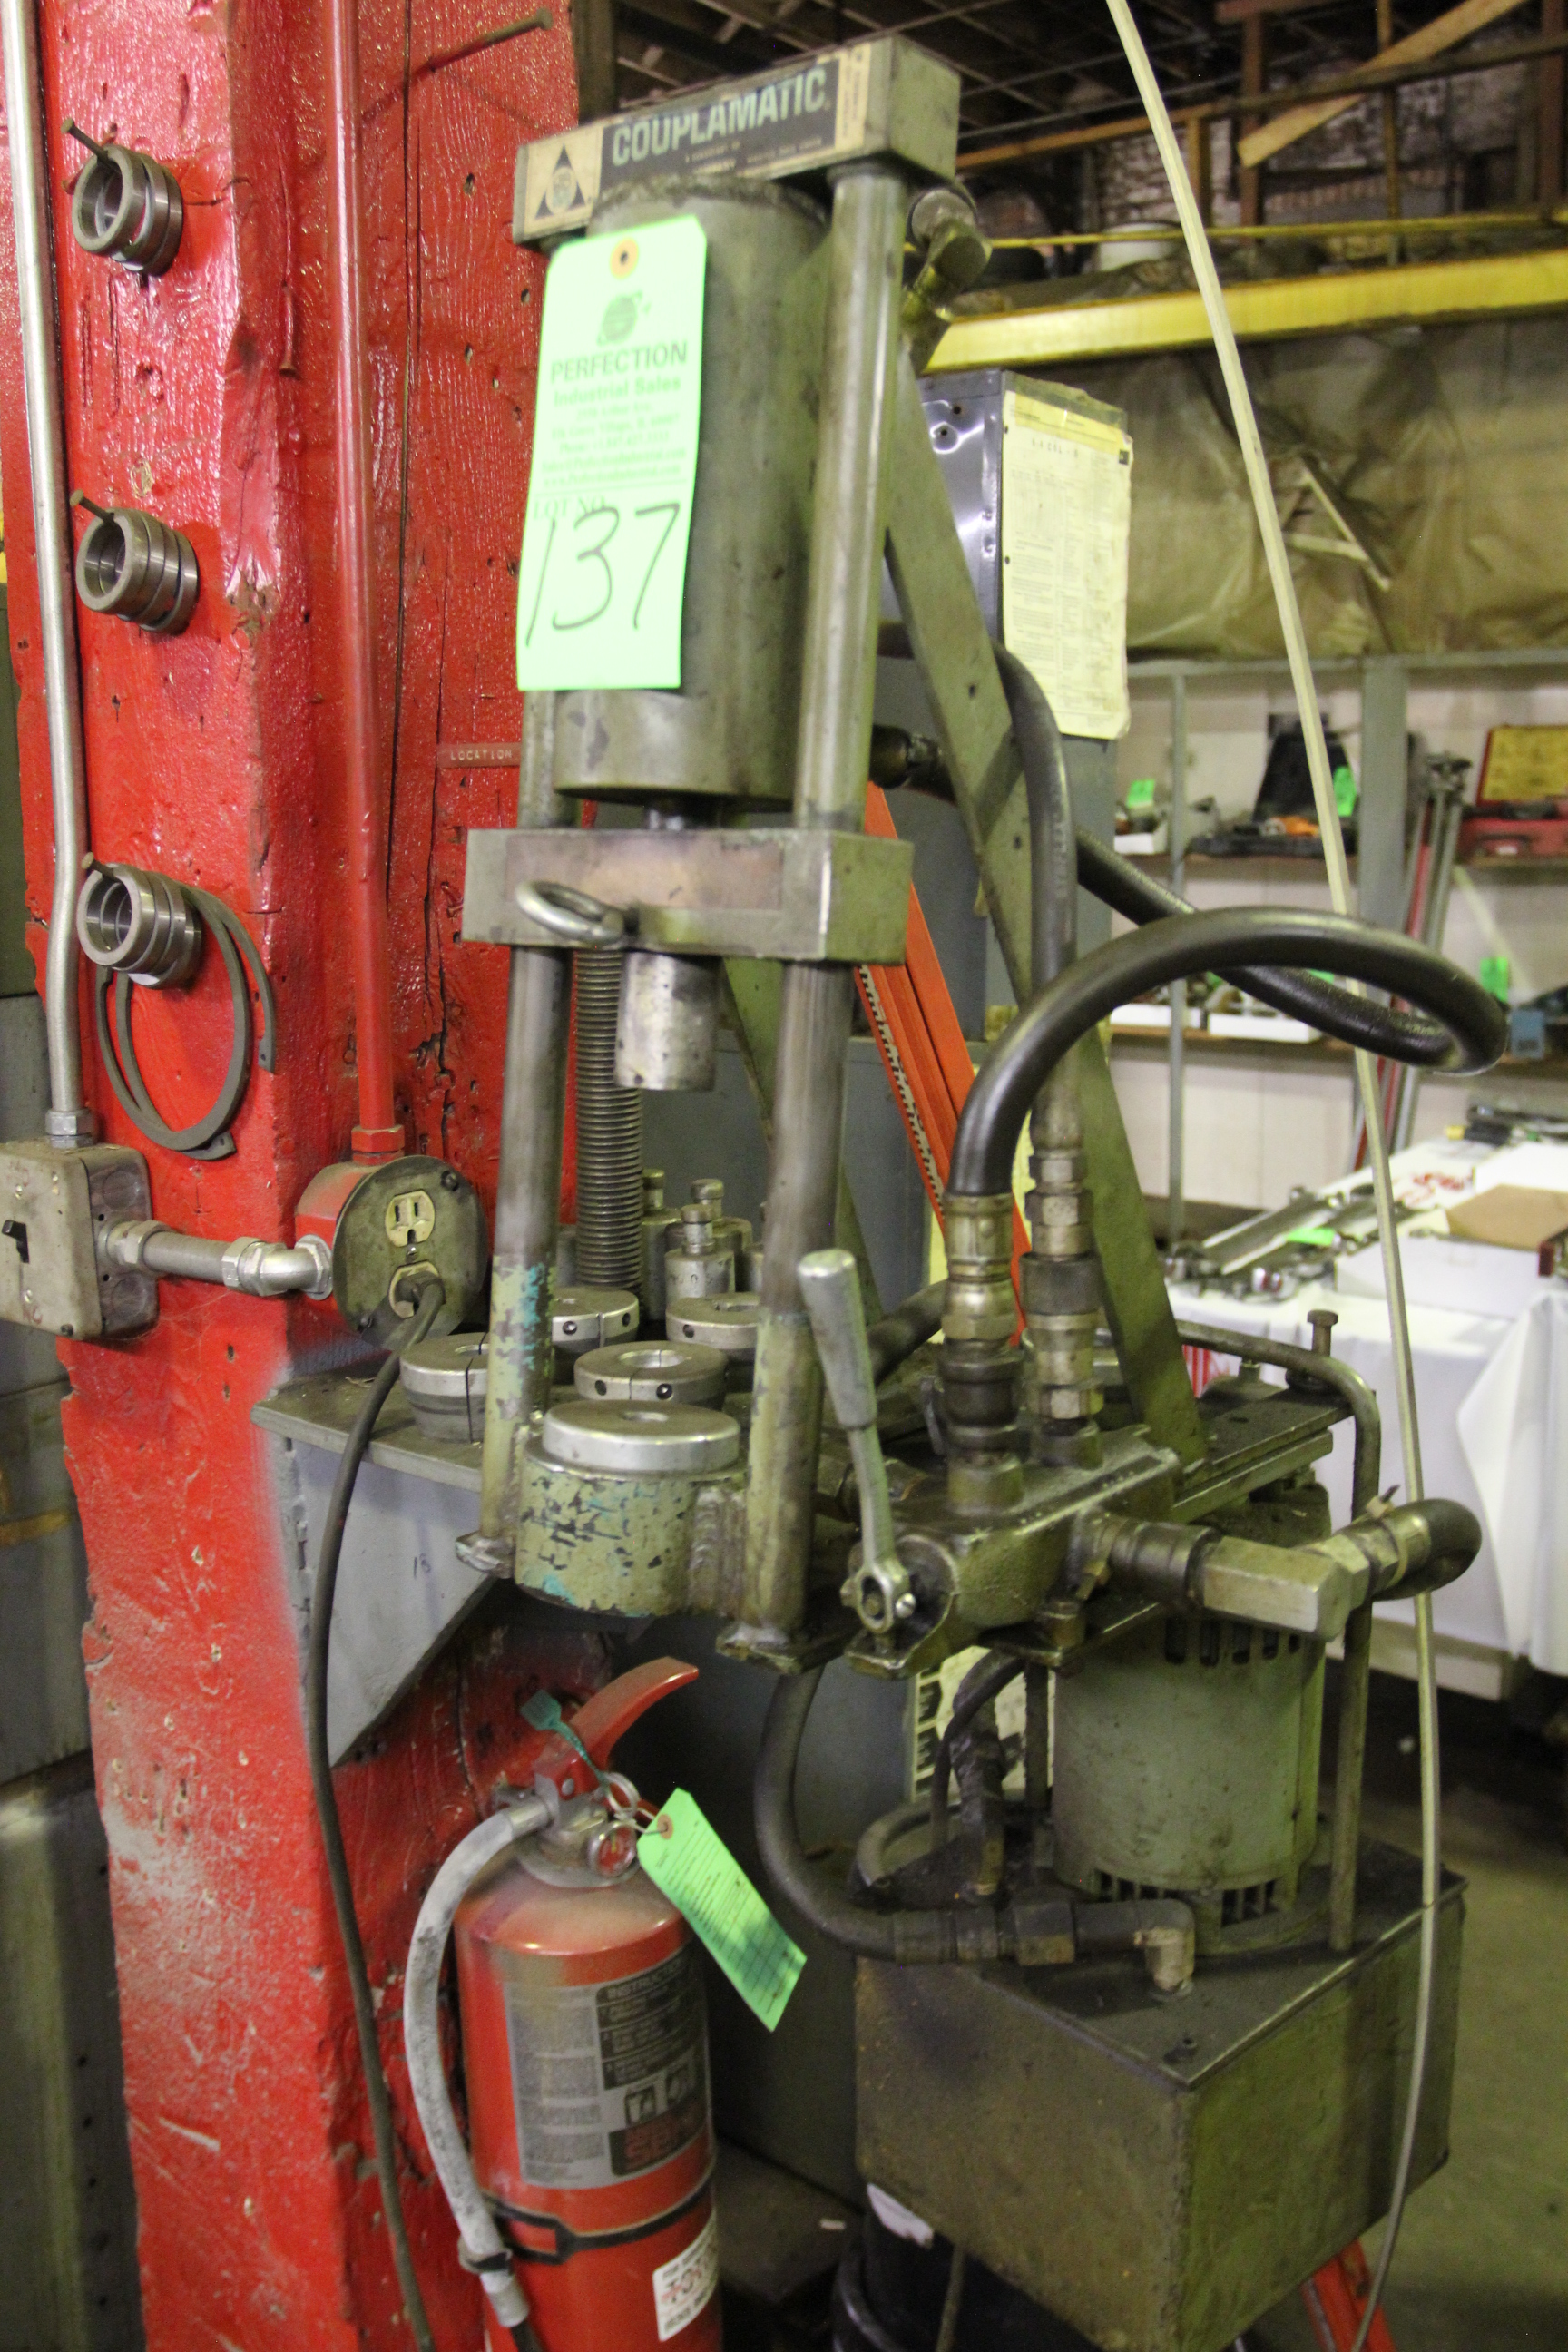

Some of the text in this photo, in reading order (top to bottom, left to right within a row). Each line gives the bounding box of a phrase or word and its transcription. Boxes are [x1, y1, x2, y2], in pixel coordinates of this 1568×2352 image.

[612, 69, 828, 167] COUPLAMATIC
[551, 341, 687, 382] PERFECTION
[554, 374, 681, 407] Industrial Sales
[525, 502, 681, 648] 137
[450, 750, 512, 760] LOCATION
